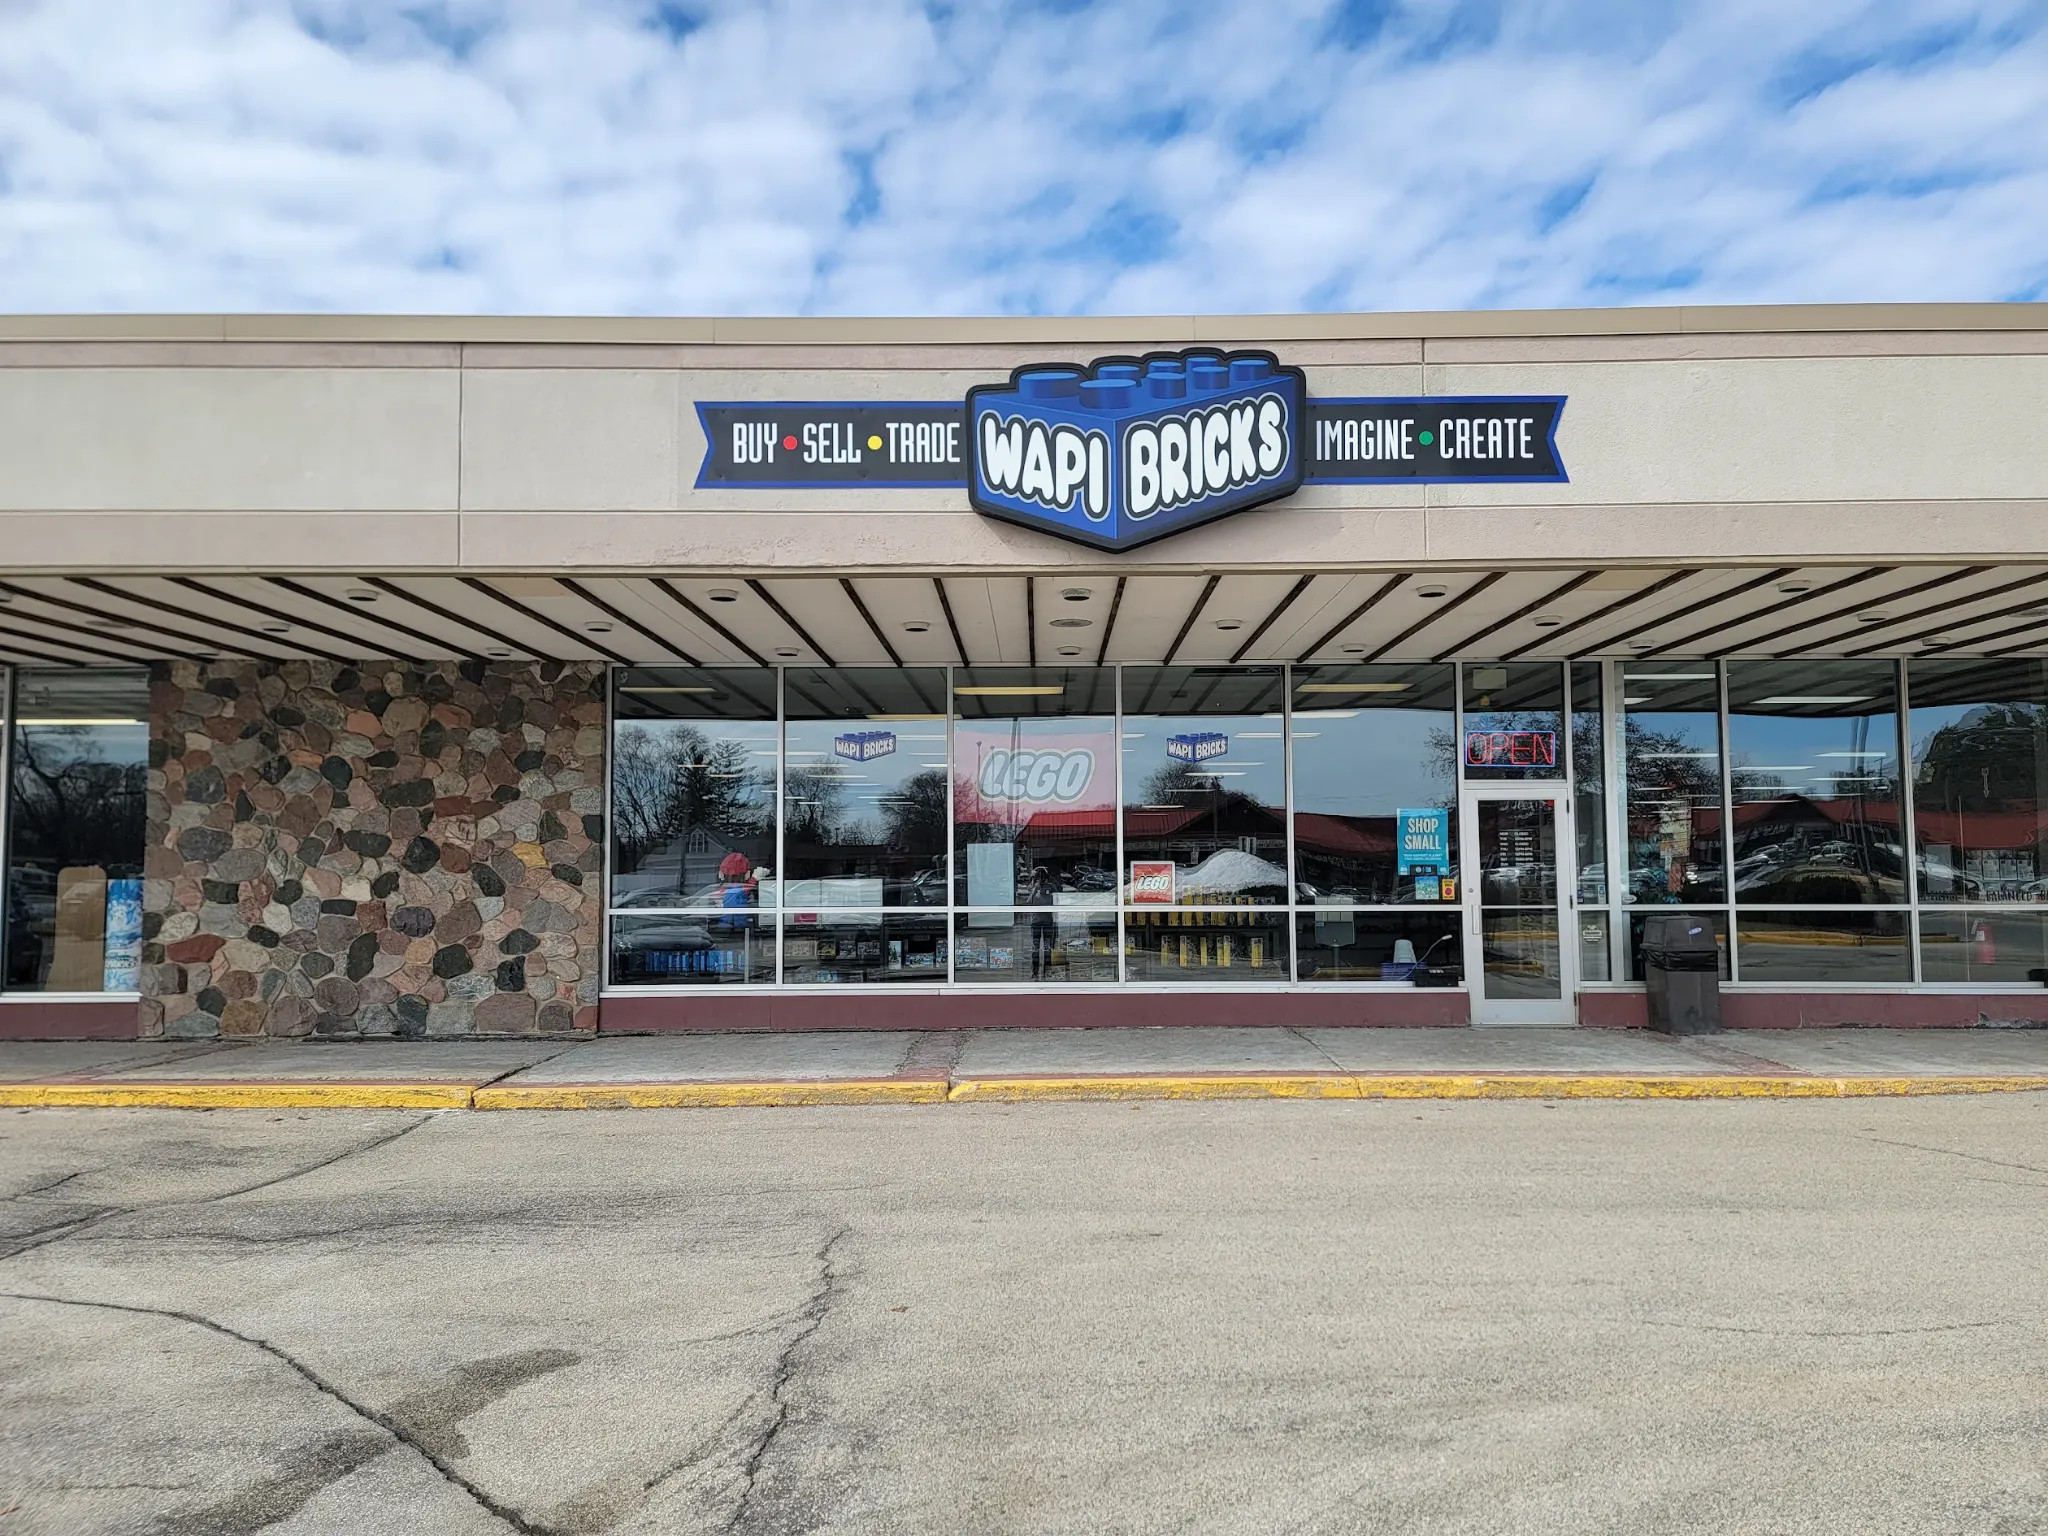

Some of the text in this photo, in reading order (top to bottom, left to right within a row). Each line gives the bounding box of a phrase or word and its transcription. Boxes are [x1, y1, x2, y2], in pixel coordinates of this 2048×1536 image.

[732, 422, 961, 463] BUY SELL TRADE
[1316, 418, 1534, 461] IMAGINE CREATE
[984, 399, 1284, 515] WAPI BRICKS
[836, 738, 894, 758] WAPI BRICKS
[1168, 739, 1226, 759] WAPI BRICKS
[1467, 733, 1554, 765] OPEN
[980, 751, 1092, 800] LEGO
[1407, 817, 1439, 834] SHOP
[1404, 834, 1442, 850] SMALL
[1137, 875, 1170, 891] LEGO
